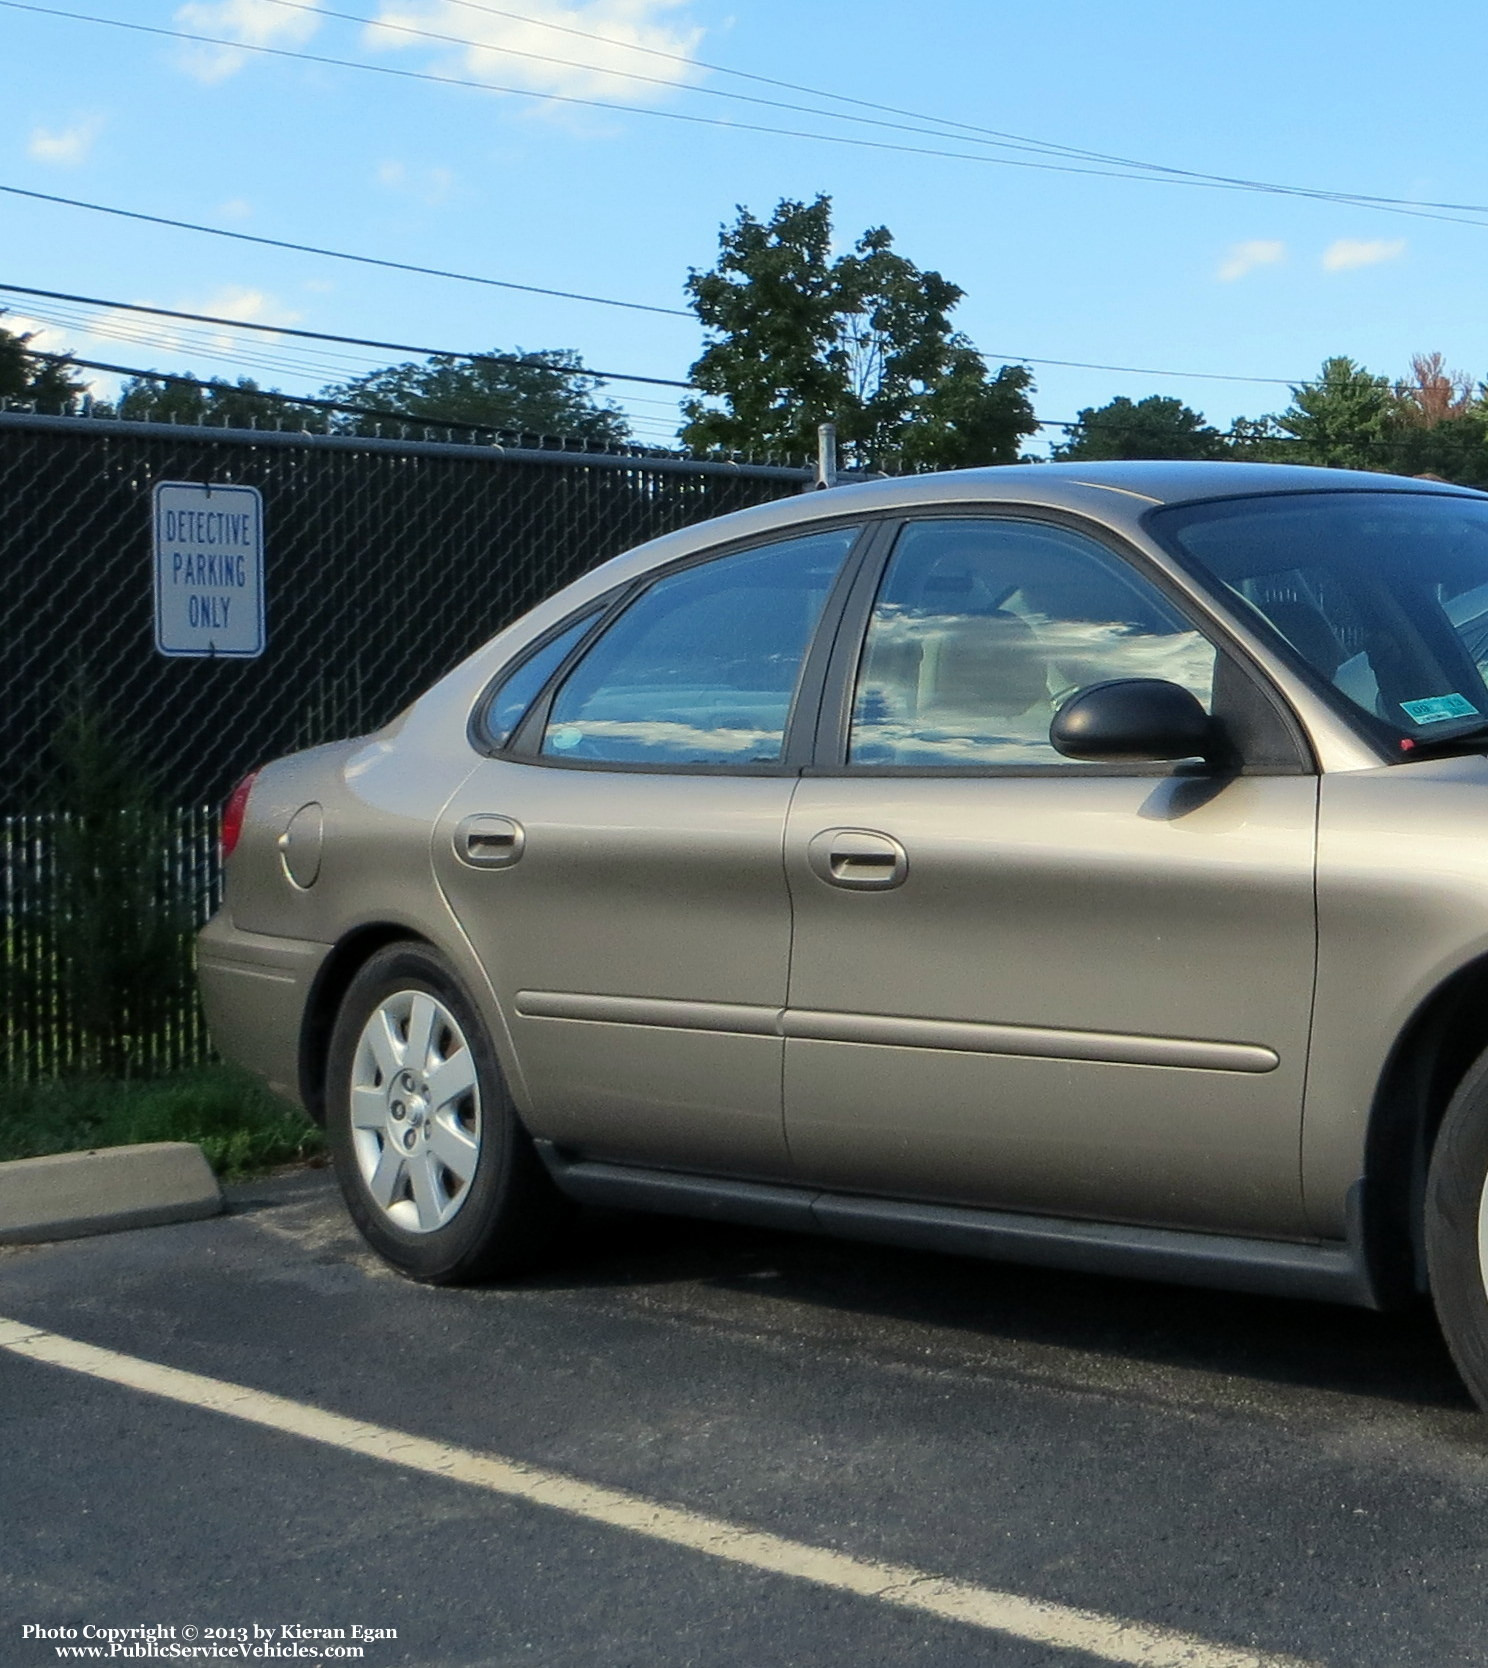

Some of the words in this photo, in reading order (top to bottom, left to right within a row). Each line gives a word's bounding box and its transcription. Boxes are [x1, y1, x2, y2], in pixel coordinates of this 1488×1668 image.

[166, 510, 250, 546] DETECTIVE
[173, 552, 246, 588] PARKING
[189, 594, 231, 628] ONLY
